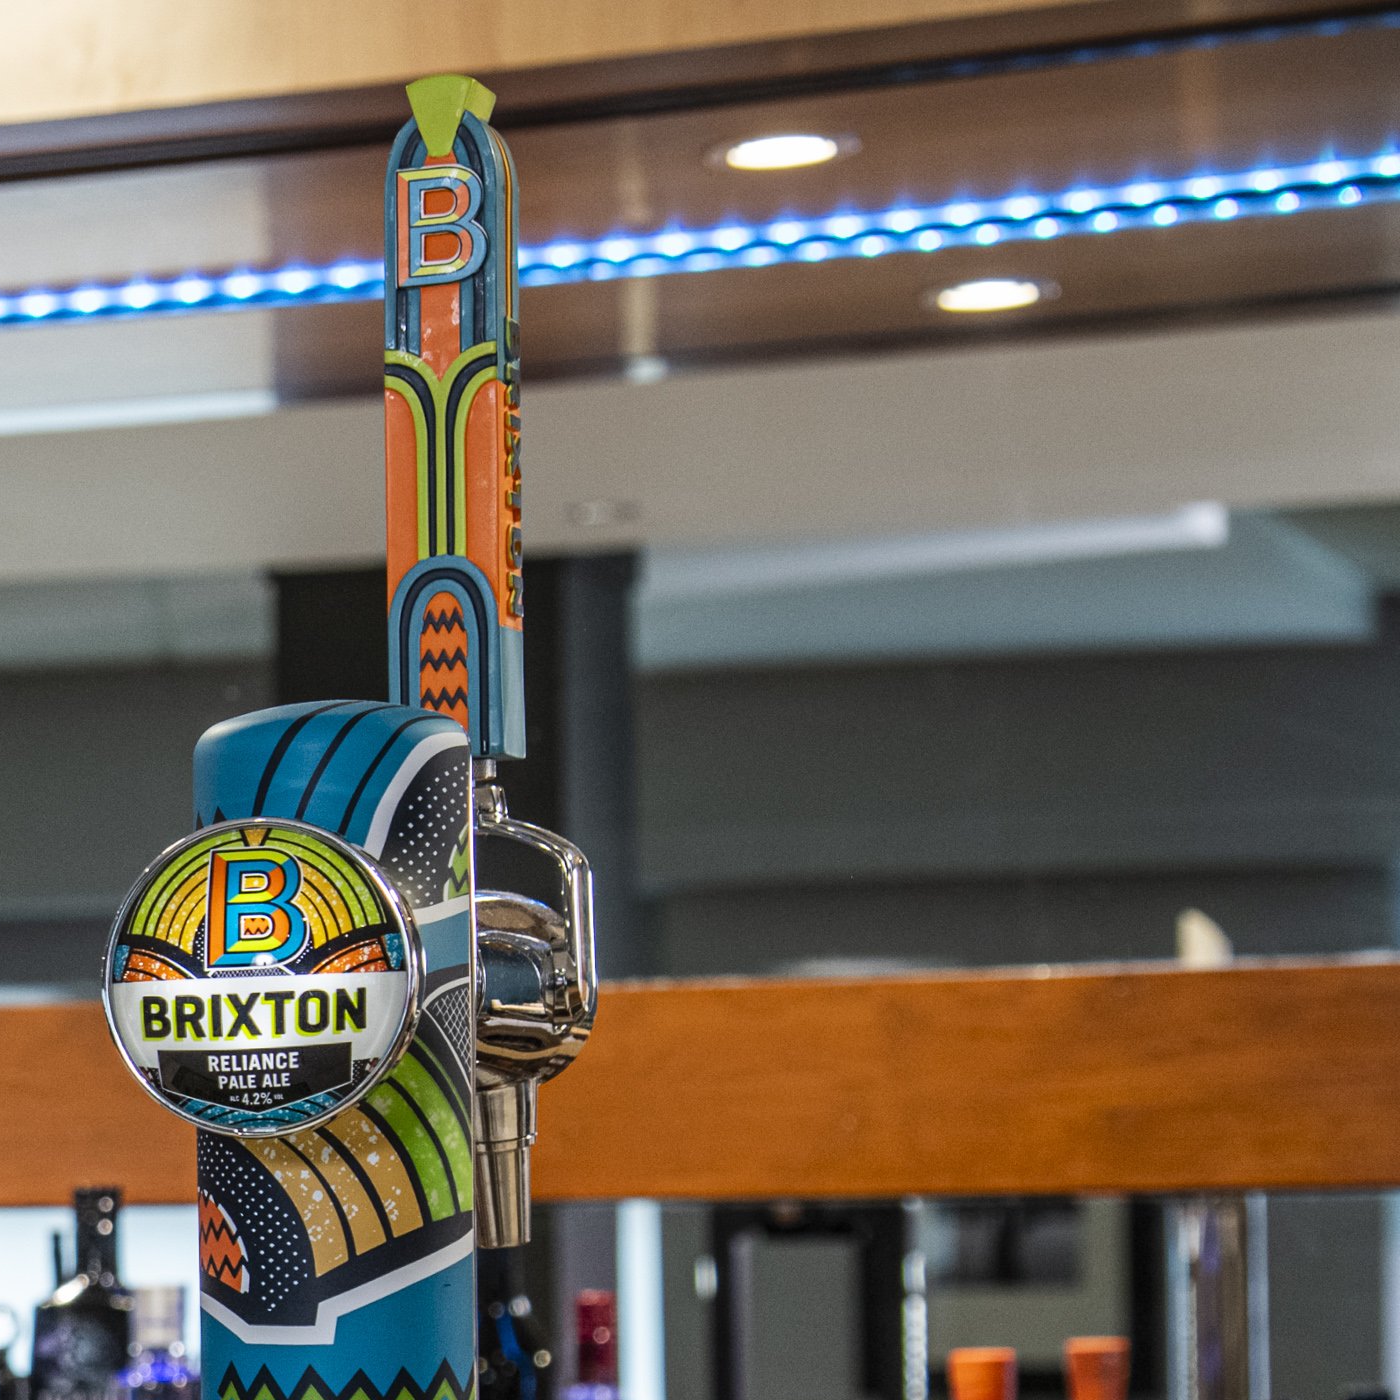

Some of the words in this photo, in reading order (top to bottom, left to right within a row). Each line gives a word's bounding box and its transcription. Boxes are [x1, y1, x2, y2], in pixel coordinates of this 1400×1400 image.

[142, 987, 367, 1042] BRIXTON
[207, 1051, 299, 1073] RELIANCE
[218, 1074, 257, 1090] PALE
[262, 1072, 291, 1088] ALE
[241, 1092, 273, 1106] 4.2%
